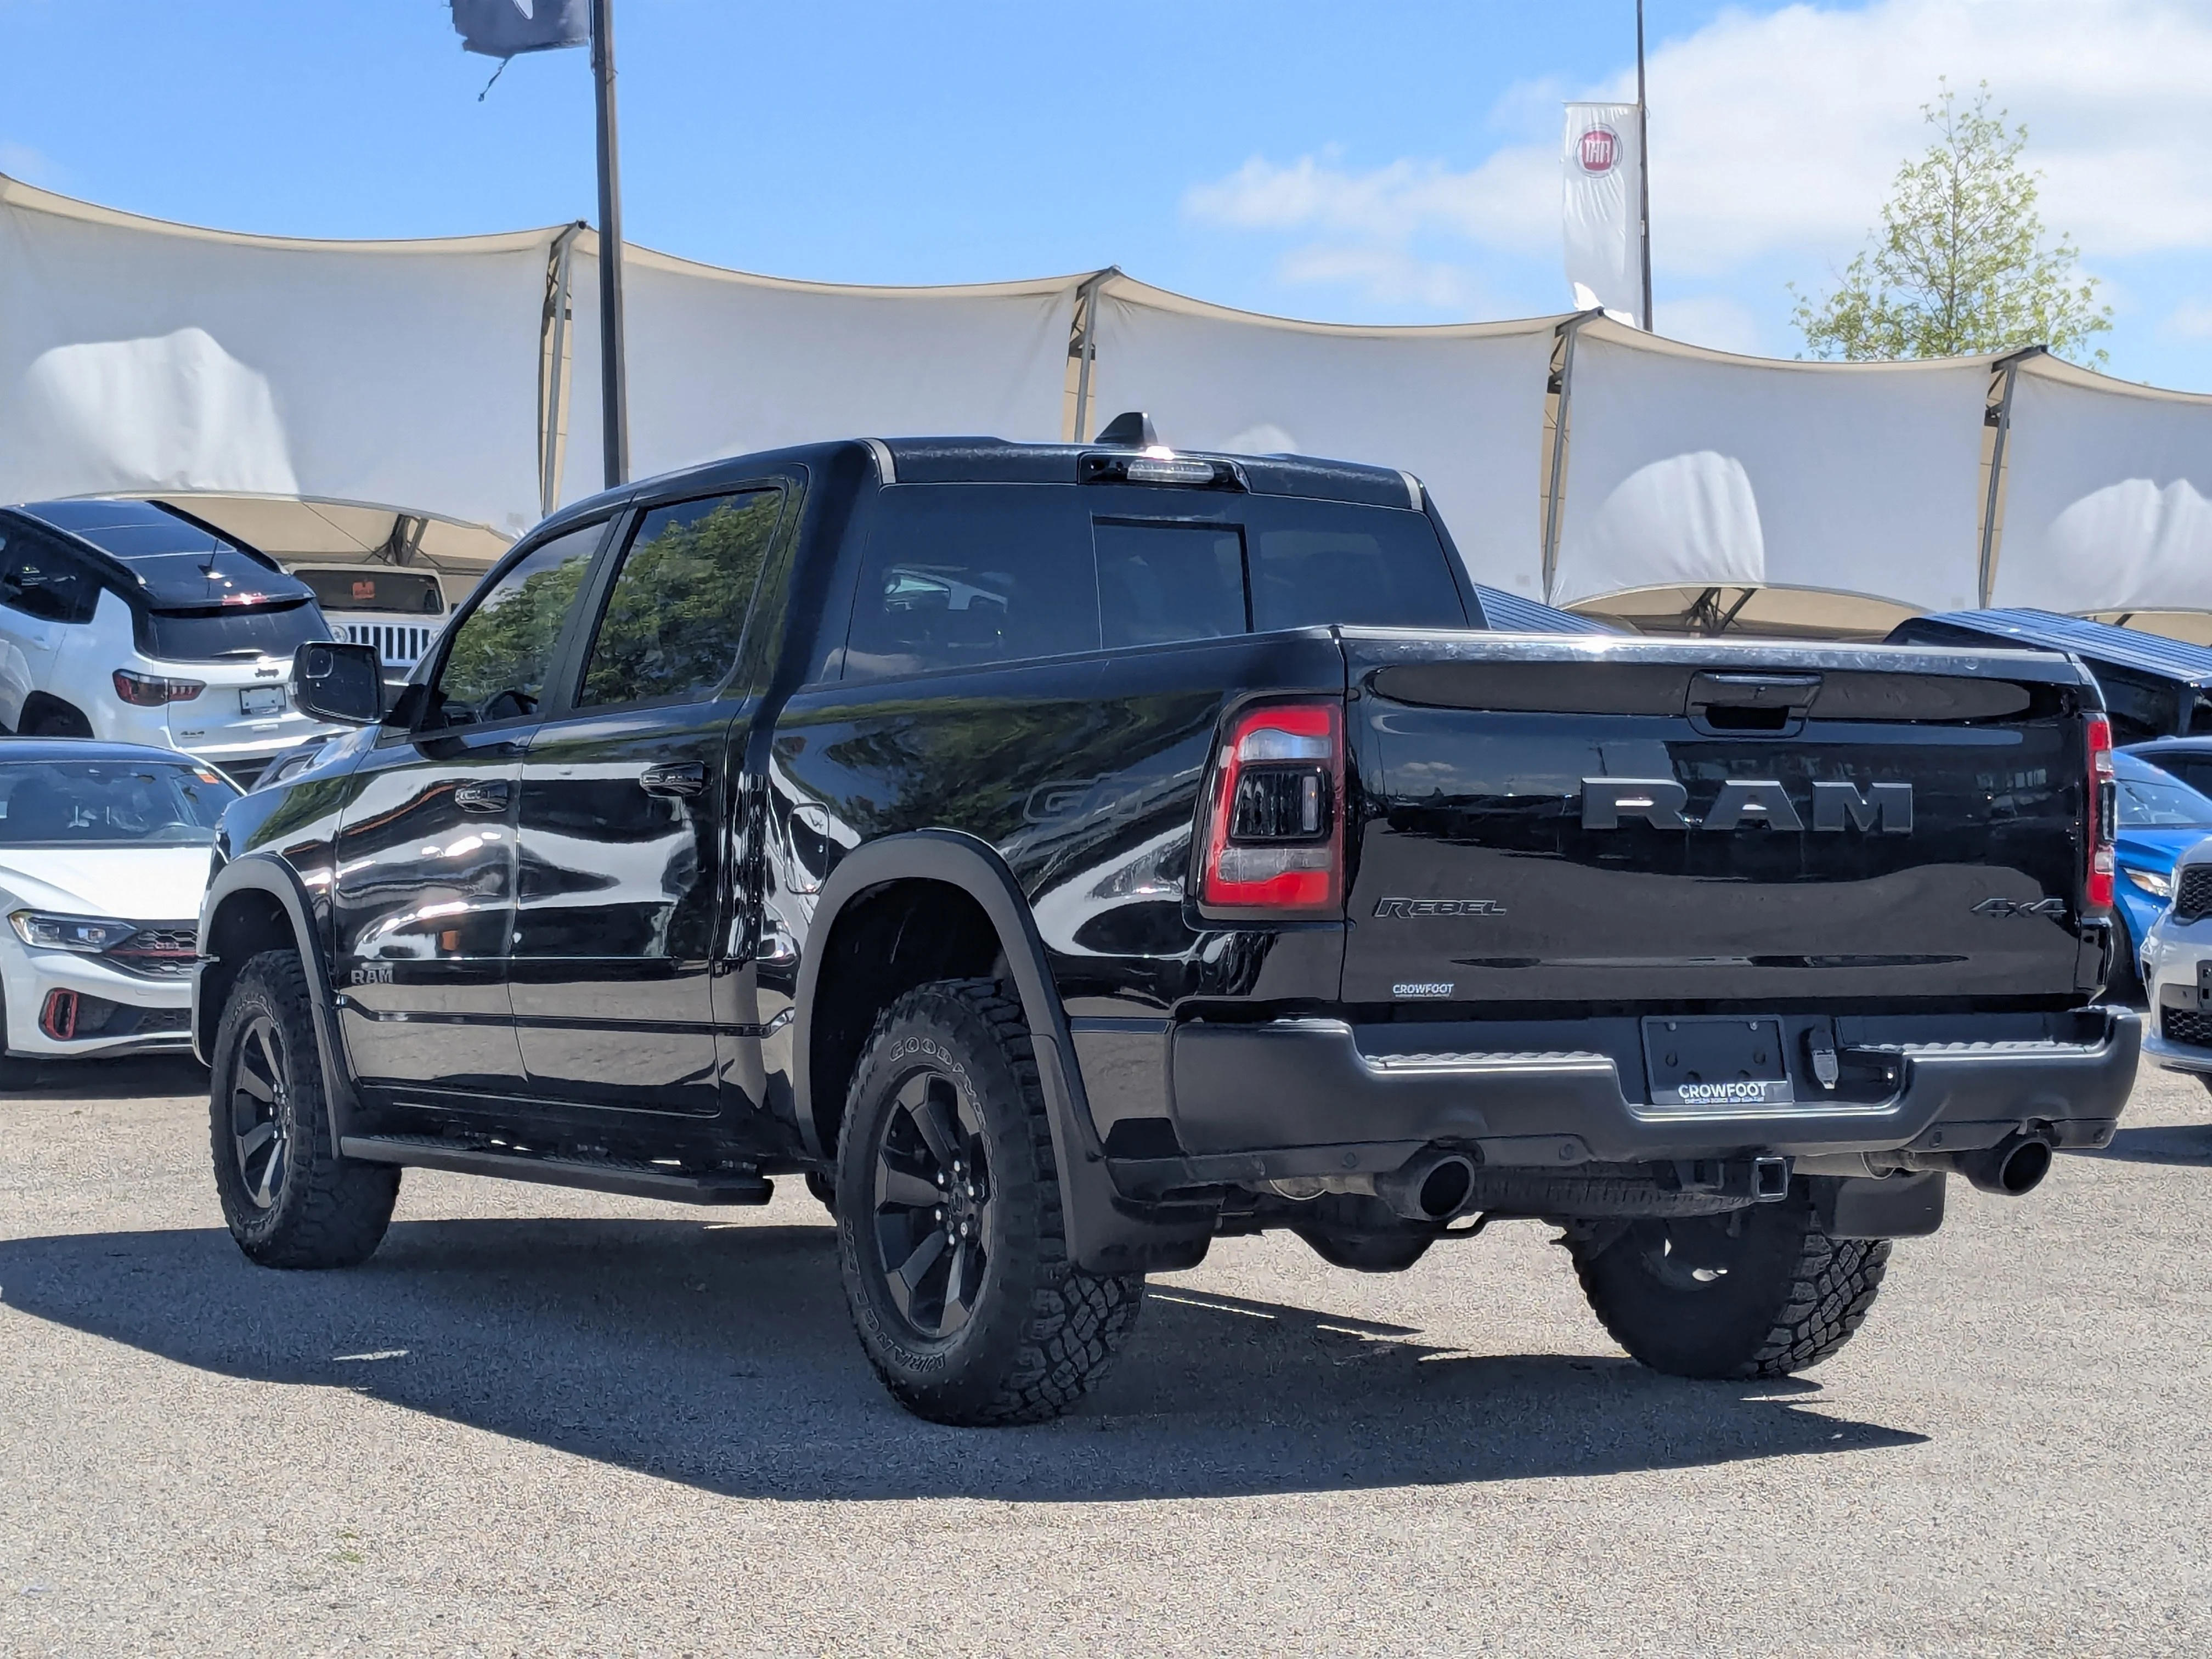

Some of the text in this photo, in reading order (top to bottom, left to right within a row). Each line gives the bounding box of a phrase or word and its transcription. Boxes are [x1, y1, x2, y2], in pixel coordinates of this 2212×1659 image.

[1582, 777, 1914, 832] RAM
[1372, 896, 1507, 919] REBEL
[1970, 898, 2068, 918] 4x4
[351, 969, 393, 985] RAM
[1392, 984, 1454, 994] CROWFOOT
[1678, 1082, 1768, 1098] CROWFOOT
